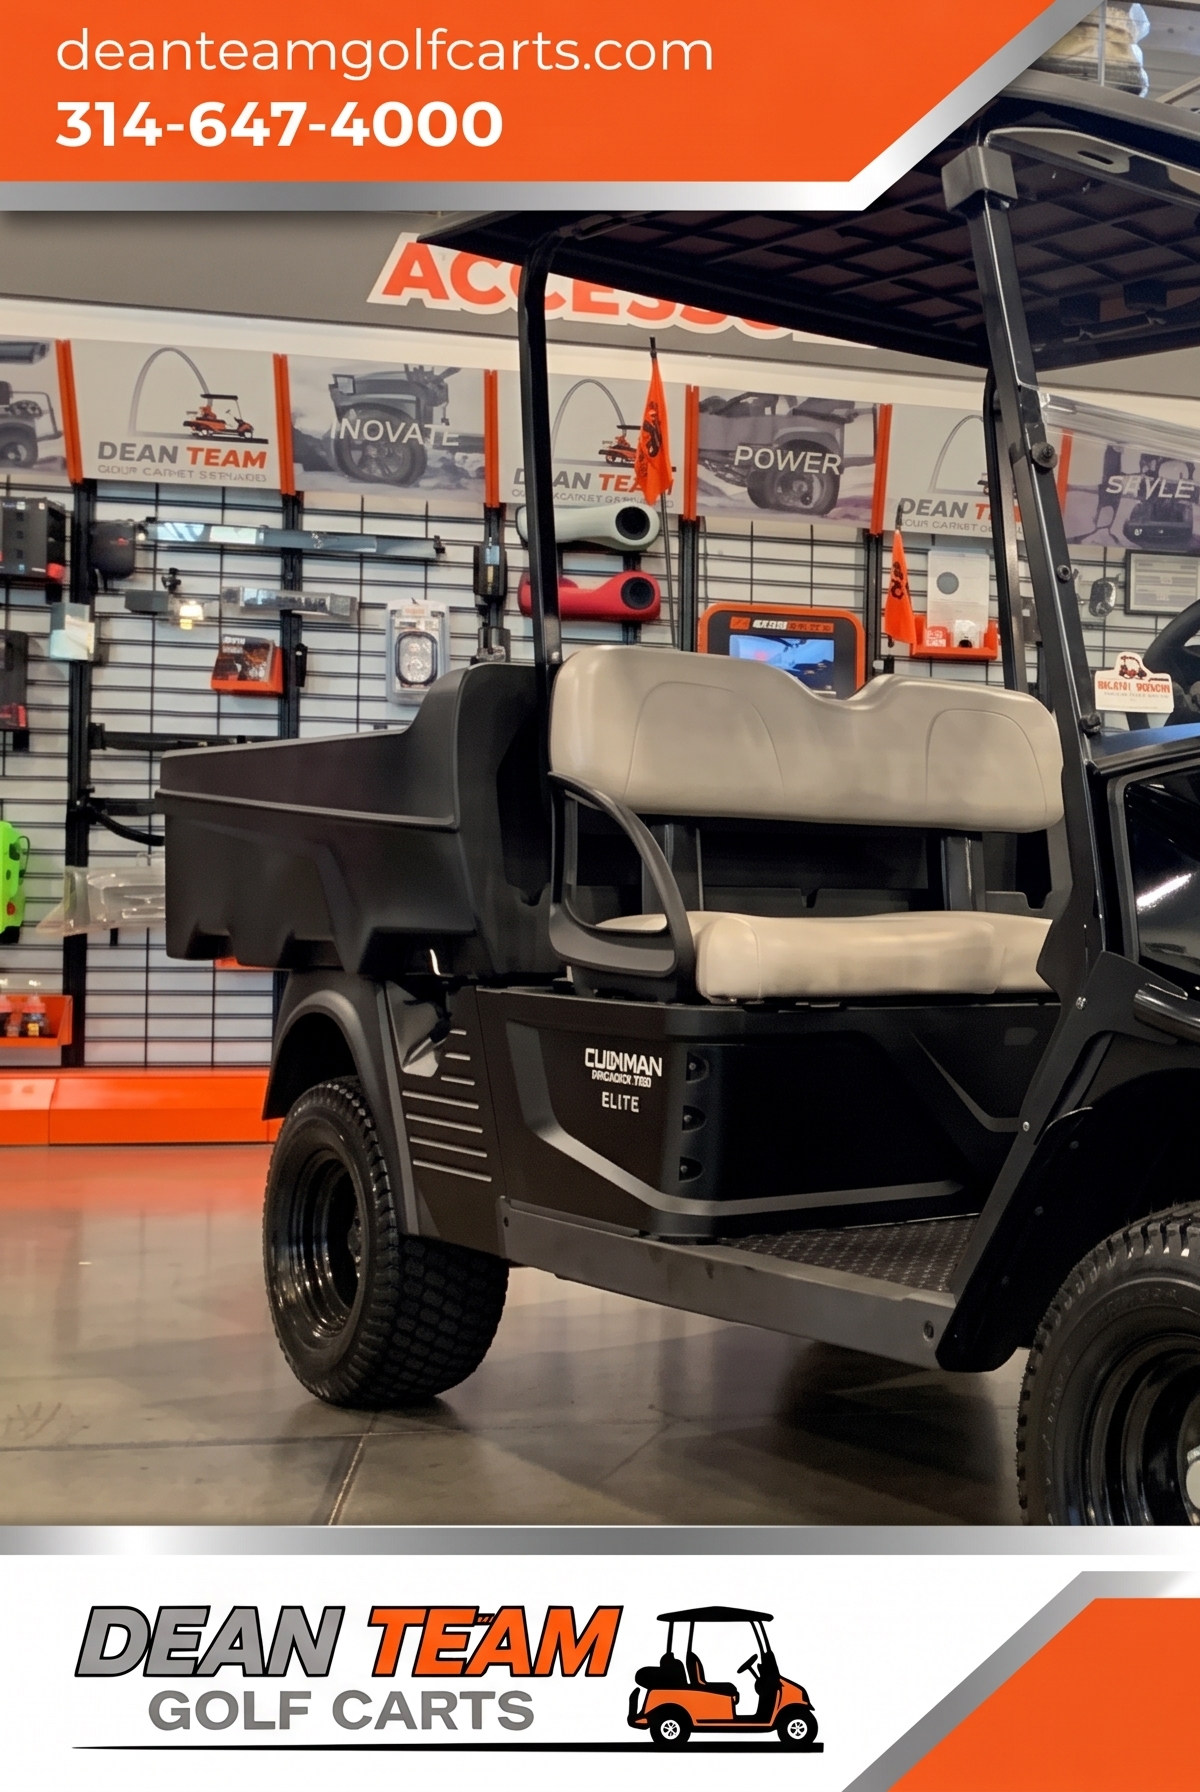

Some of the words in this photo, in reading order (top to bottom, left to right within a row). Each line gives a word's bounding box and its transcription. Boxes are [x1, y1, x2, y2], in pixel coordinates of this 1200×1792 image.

[98, 441, 179, 464] DEAN
[186, 446, 267, 469] TEAM
[734, 445, 842, 475] POWER
[513, 467, 592, 490] DAN
[899, 497, 969, 519] DEAN
[601, 1091, 639, 1112] ELITE
